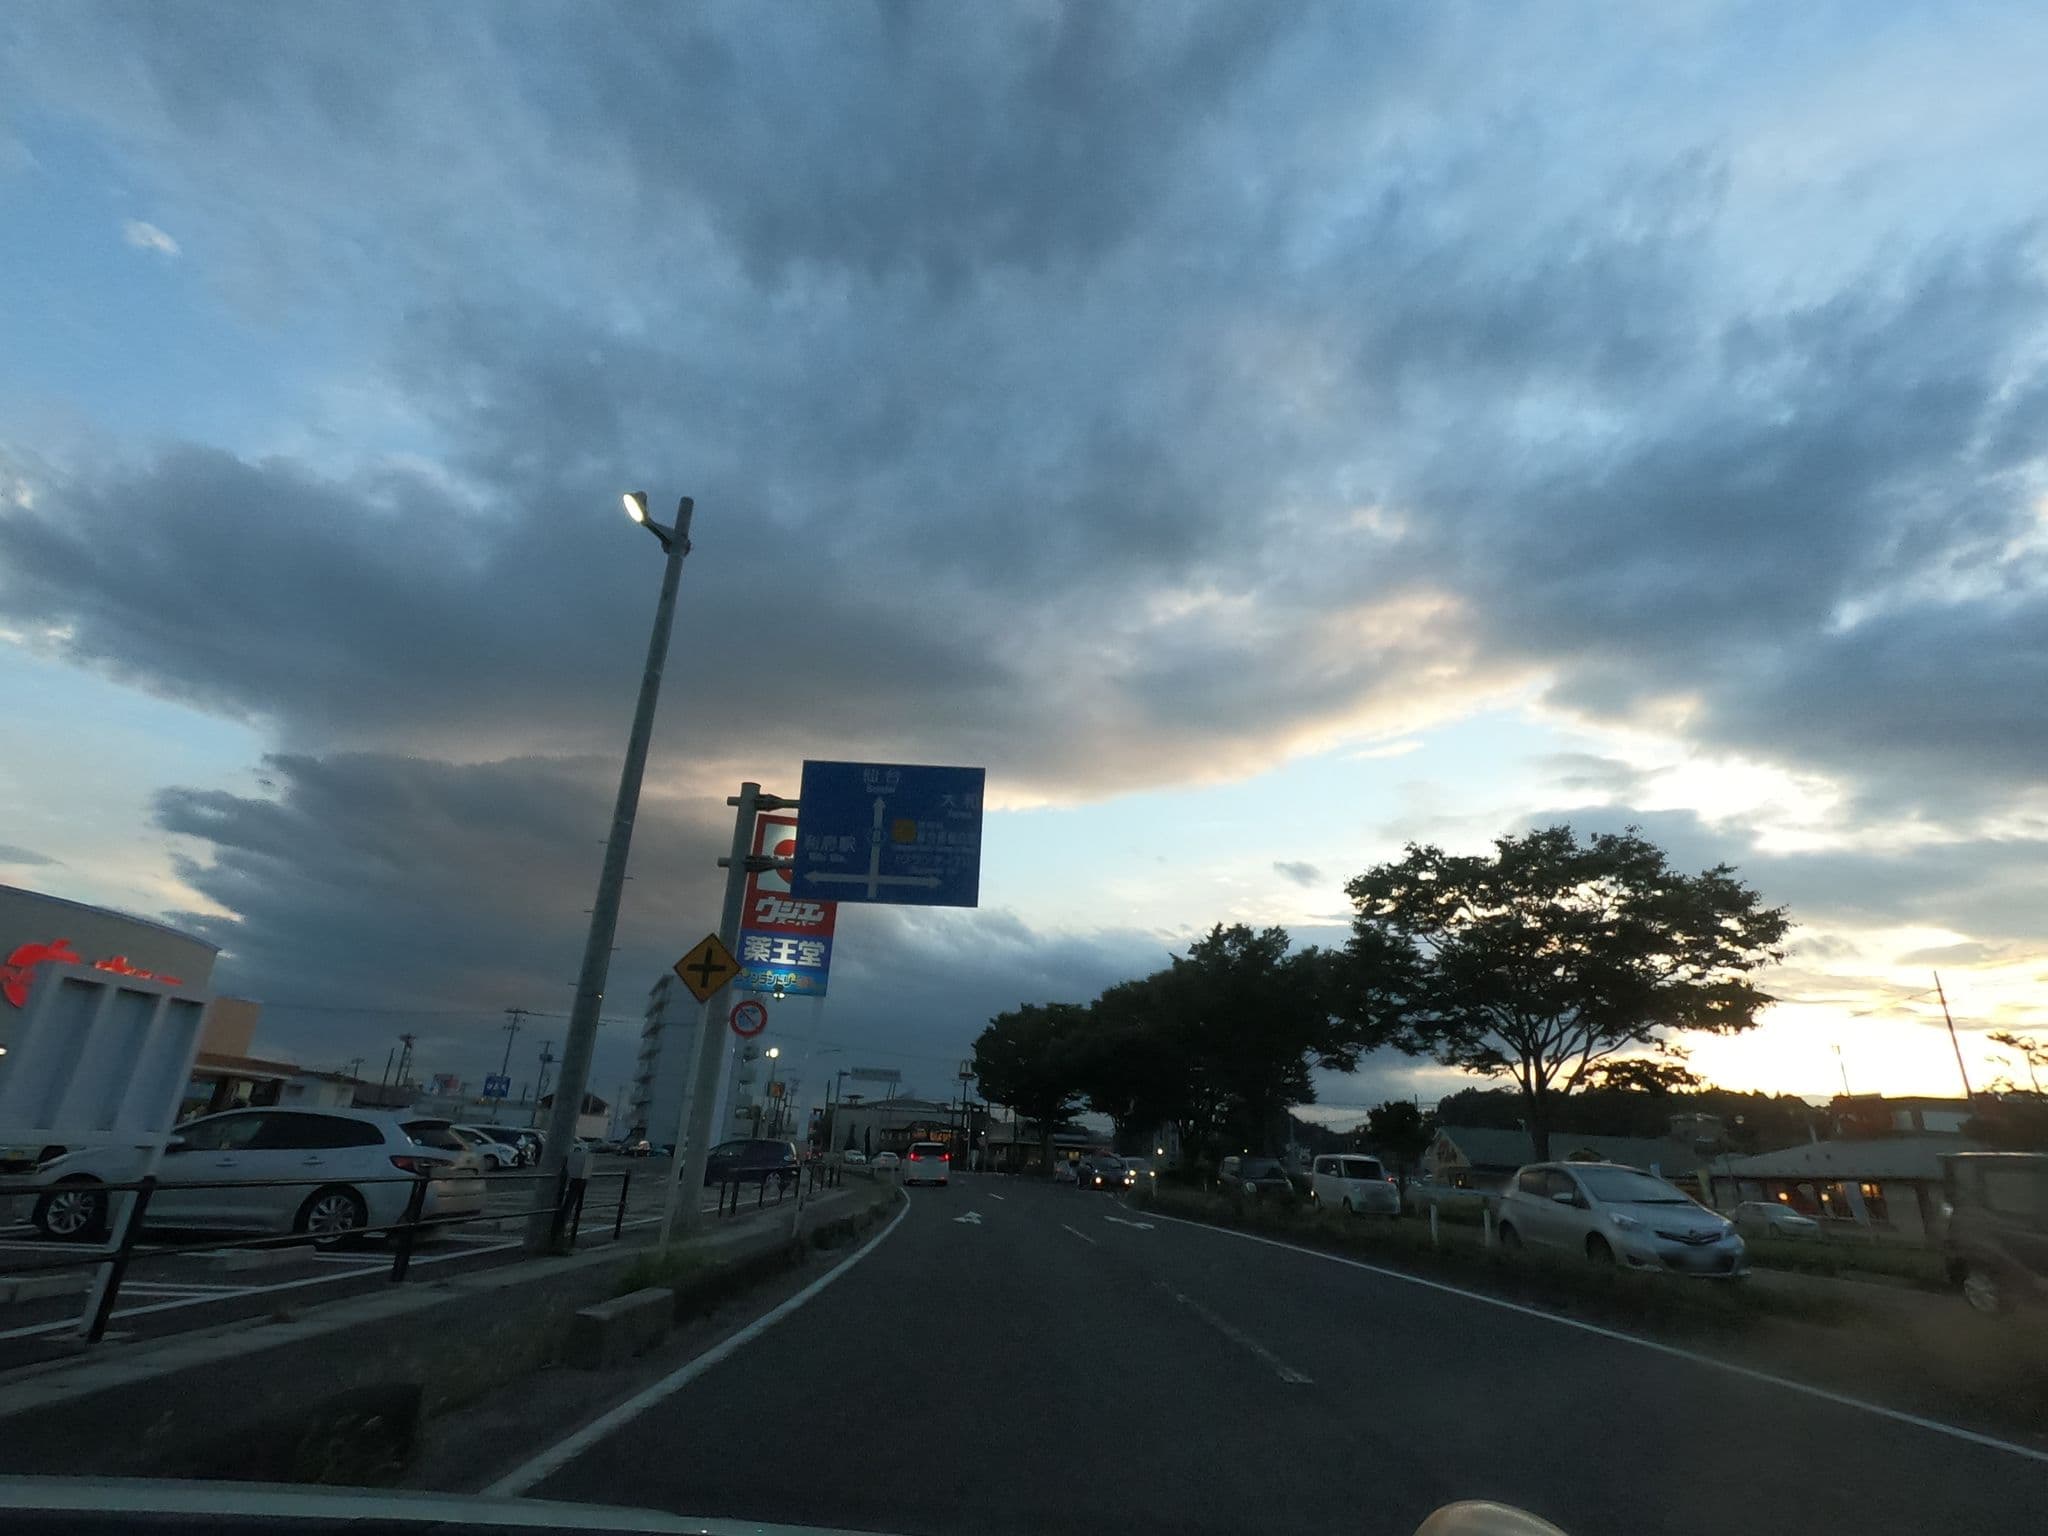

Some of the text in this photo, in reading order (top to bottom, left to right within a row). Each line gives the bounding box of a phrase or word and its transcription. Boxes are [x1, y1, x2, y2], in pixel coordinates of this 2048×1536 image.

[755, 896, 825, 923] ウジエ
[743, 935, 825, 968] 薬王堂
